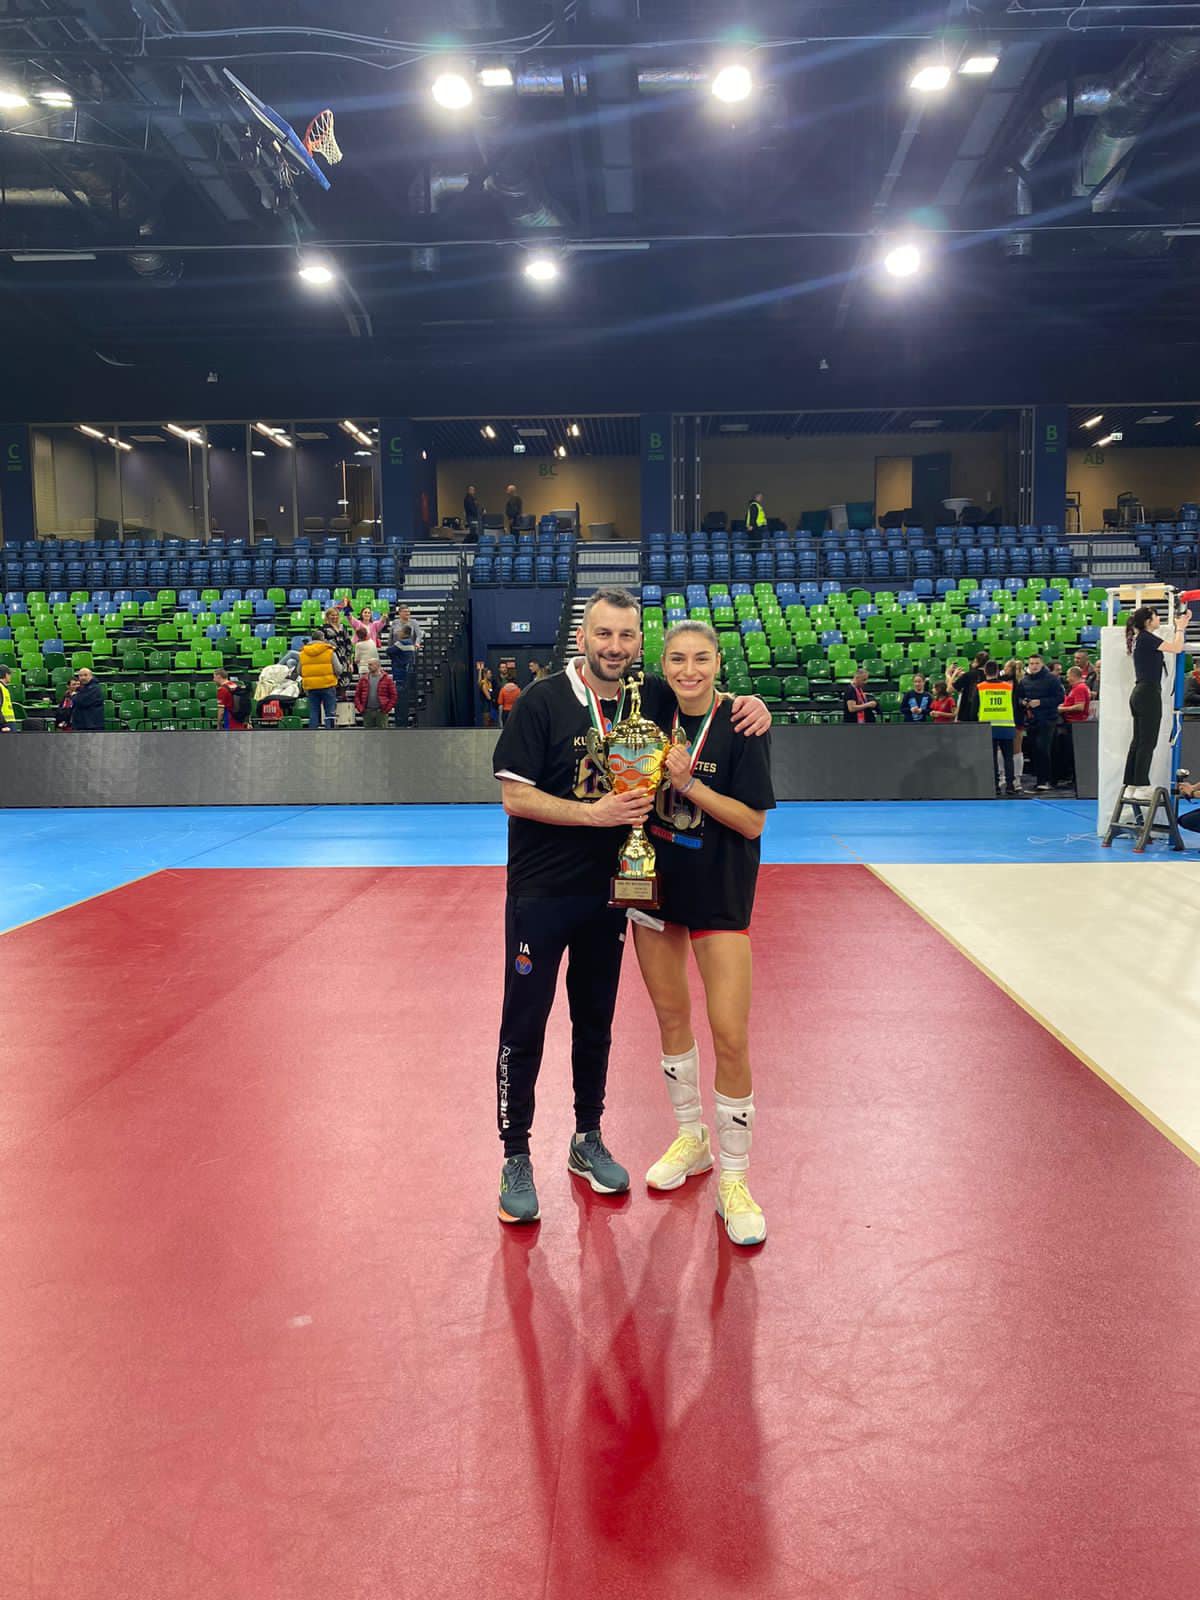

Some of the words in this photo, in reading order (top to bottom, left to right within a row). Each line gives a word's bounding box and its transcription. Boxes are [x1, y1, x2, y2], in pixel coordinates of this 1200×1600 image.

[650, 432, 662, 449] B
[1047, 425, 1057, 441] B
[8, 444, 19, 459] C
[390, 436, 402, 453] C
[1084, 450, 1105, 464] AB
[990, 697, 1002, 705] 110
